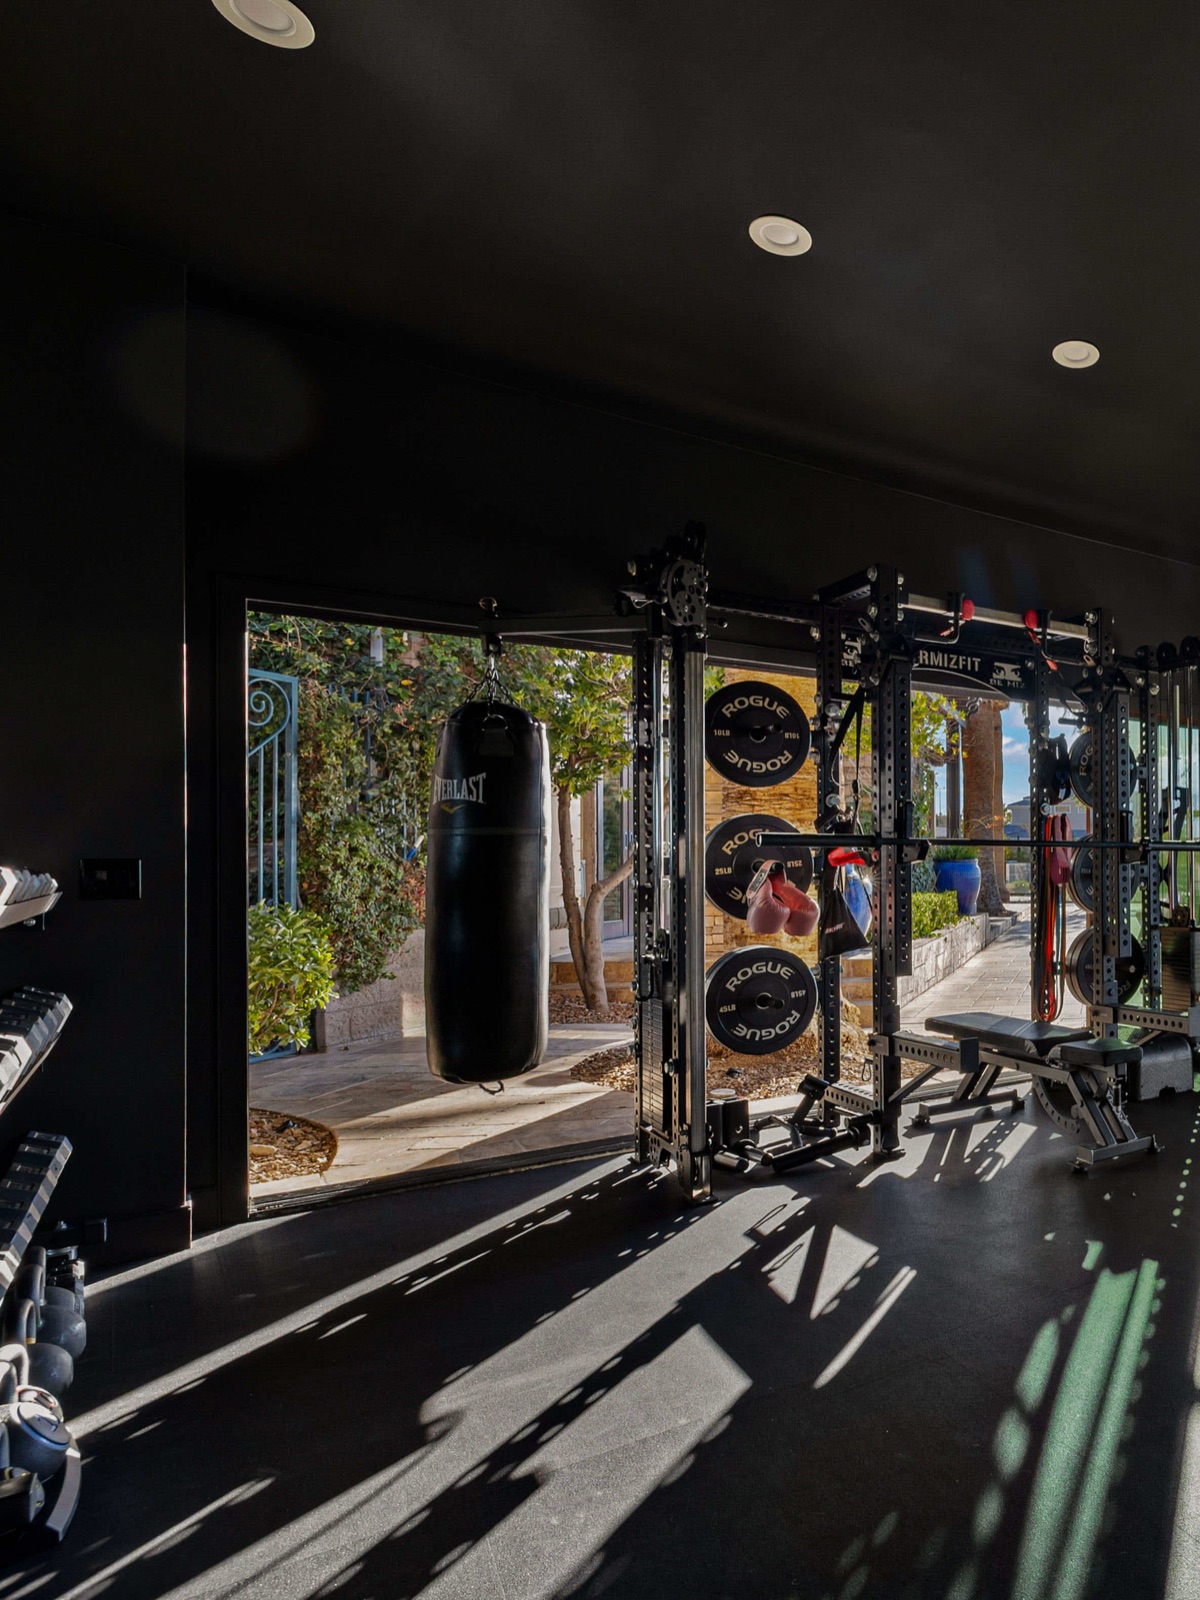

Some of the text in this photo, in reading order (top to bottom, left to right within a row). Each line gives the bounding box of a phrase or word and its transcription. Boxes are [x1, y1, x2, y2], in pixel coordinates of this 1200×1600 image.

[919, 649, 981, 672] RMIZFIT
[721, 695, 790, 719] ROGUE
[713, 728, 731, 737] 10LB
[784, 732, 800, 740] 10LB
[723, 749, 793, 773] ROGUE
[432, 772, 487, 806] EVERLAST
[714, 866, 733, 876] 25LB
[725, 961, 795, 993] ROGUE
[790, 989, 807, 999] 45LB
[719, 1003, 737, 1014] 45LB
[731, 1009, 801, 1041] ROGUE
